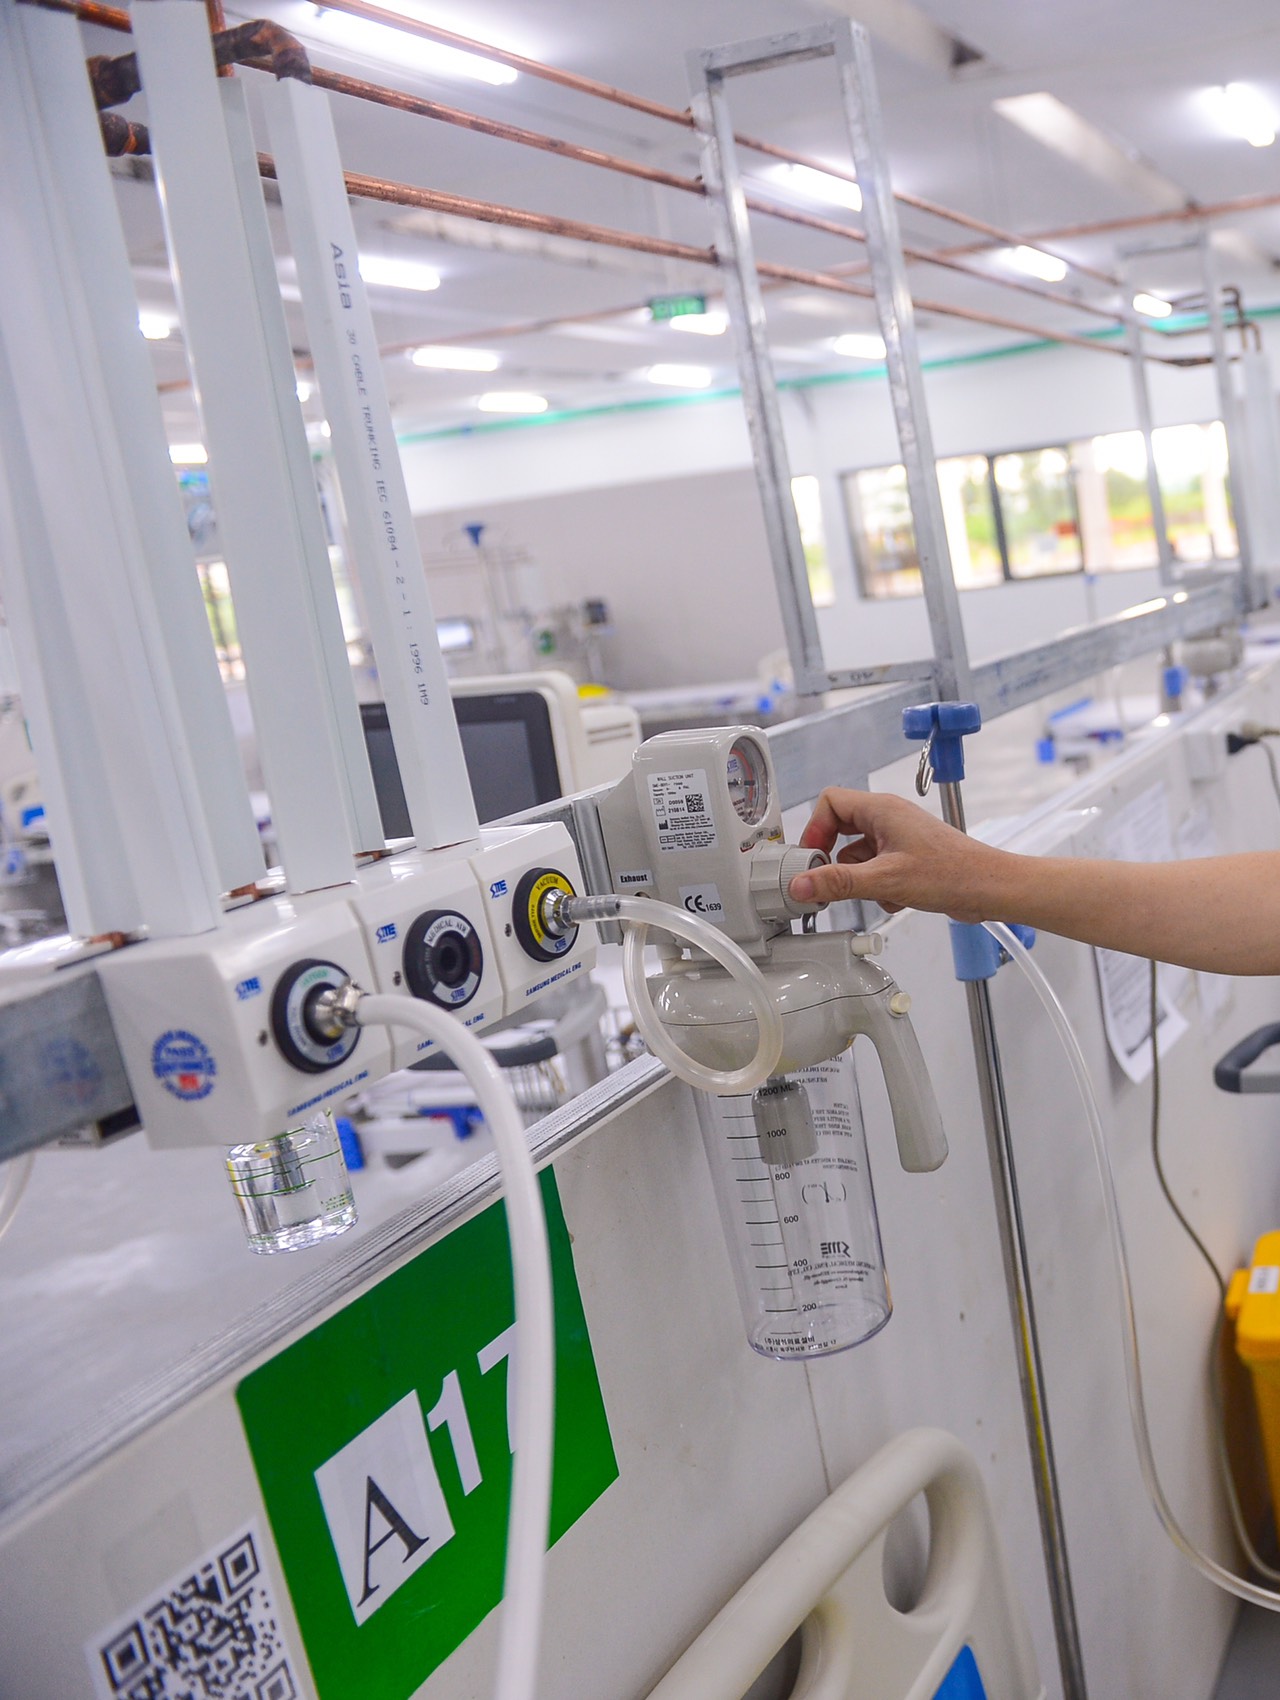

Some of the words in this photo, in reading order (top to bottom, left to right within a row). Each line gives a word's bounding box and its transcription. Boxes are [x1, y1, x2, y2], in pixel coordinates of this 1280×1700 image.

[330, 242, 352, 309] Asia
[352, 354, 367, 396] CABLE
[362, 405, 381, 471] TRUNKING
[375, 480, 388, 503] IEC
[382, 510, 398, 551] 61084
[536, 877, 559, 891] VACUUM
[620, 874, 648, 883] Exhaust
[706, 903, 722, 912] 1639
[428, 919, 453, 943] MEDICAL
[526, 978, 550, 996] SAMSUNG
[550, 968, 572, 983] MEDICAL
[572, 962, 582, 972] ENG
[758, 1087, 778, 1096] 1200
[780, 1084, 794, 1094] ML
[287, 1093, 324, 1118] SAMSUNG
[766, 1128, 787, 1138] 1000
[774, 1172, 790, 1181] 800
[784, 1214, 799, 1224] 600
[793, 1258, 808, 1268] 400
[802, 1302, 817, 1312] 200
[357, 1475, 430, 1608] A
